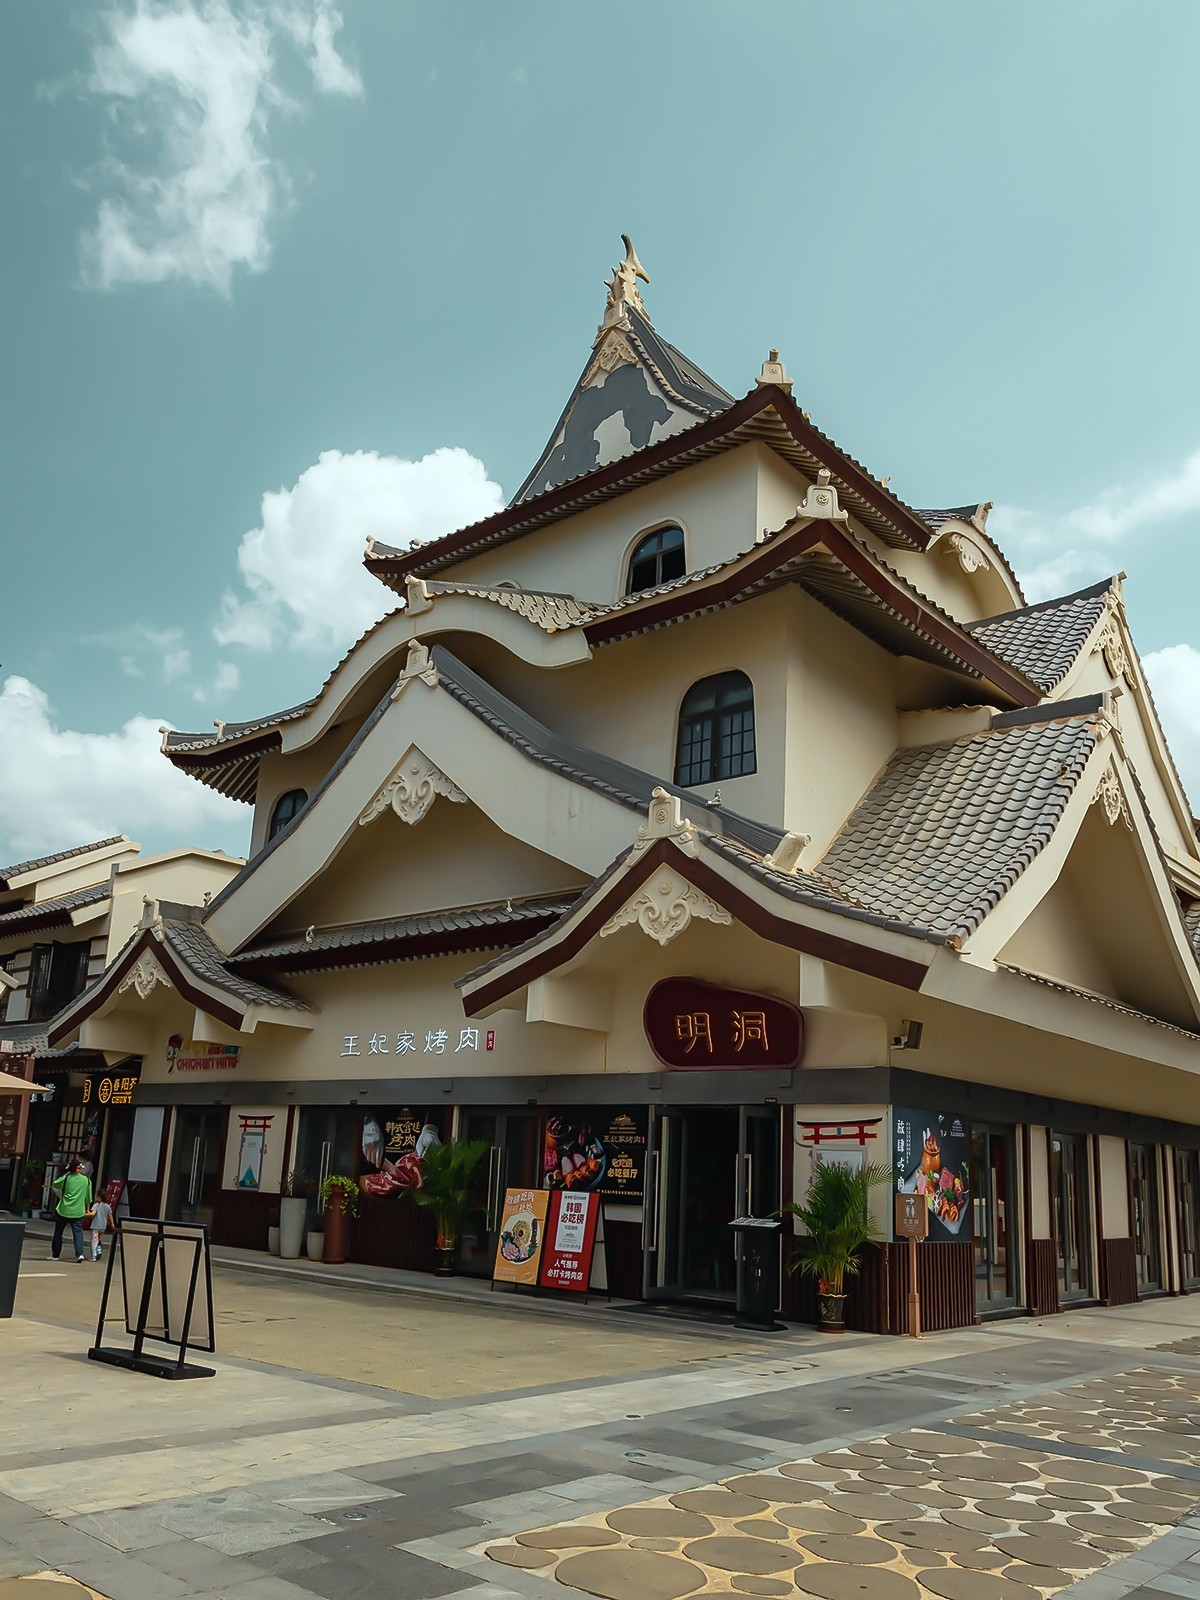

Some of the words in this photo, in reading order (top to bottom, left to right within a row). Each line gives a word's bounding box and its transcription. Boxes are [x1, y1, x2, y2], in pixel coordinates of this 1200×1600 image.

[675, 1011, 769, 1053] 明洞
[340, 1026, 479, 1056] 王妃家烤肉
[388, 1133, 416, 1147] 烤肉
[607, 1168, 638, 1178] 必吃餐厅
[566, 1202, 582, 1213] 韩国
[560, 1213, 585, 1224] 必吃榜
[554, 1260, 579, 1269] 人气推荐
[547, 1268, 583, 1280] 必打卡烤肉店
